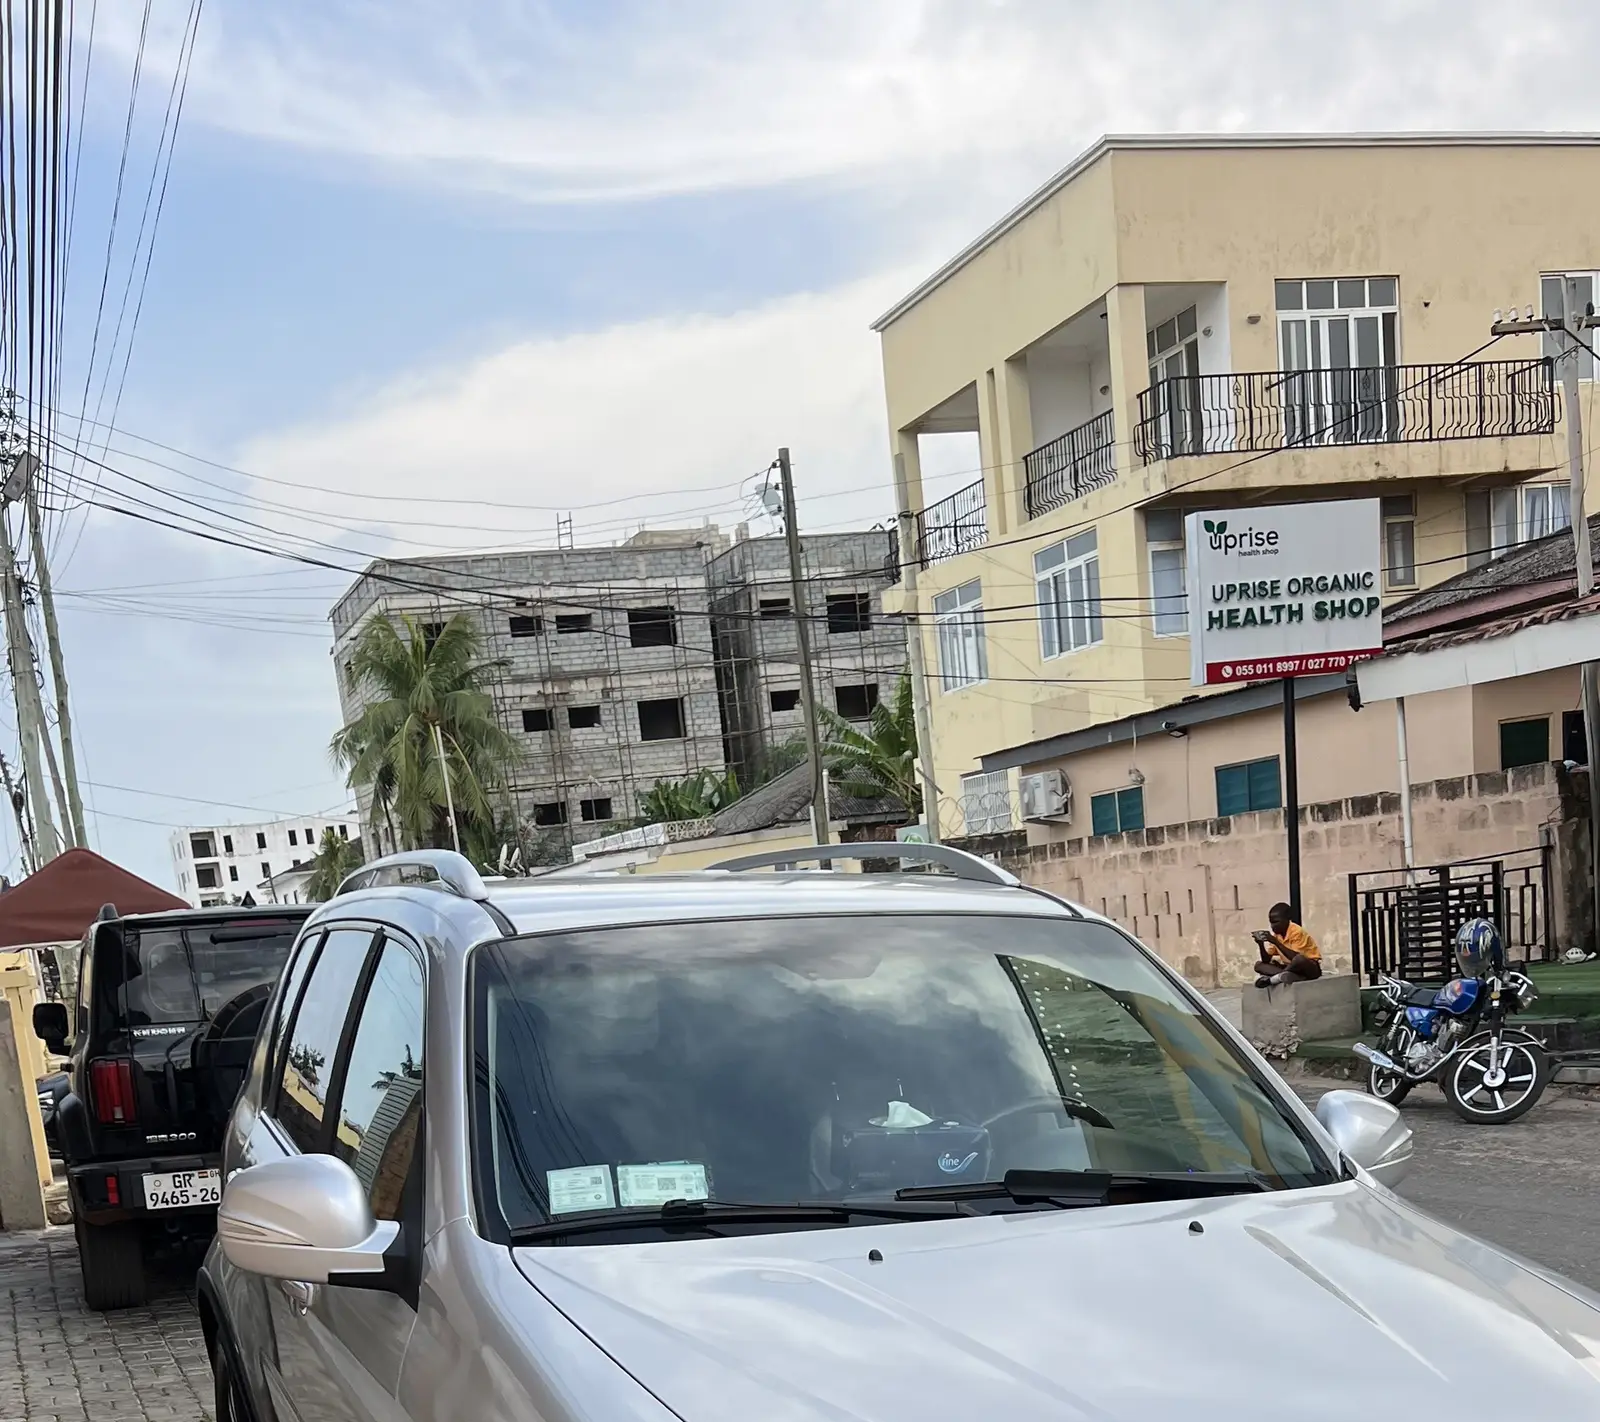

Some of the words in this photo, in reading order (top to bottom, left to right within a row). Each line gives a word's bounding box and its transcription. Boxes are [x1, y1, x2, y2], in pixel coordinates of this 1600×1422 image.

[1210, 527, 1279, 555] uprise
[1238, 549, 1260, 557] health
[1262, 548, 1279, 556] shop
[1212, 580, 1281, 602] UPRISE
[1287, 572, 1374, 597] ORGANIC
[1206, 603, 1304, 631] HEALTH
[1314, 596, 1380, 621] SHOP
[1235, 665, 1254, 676] 055
[1256, 662, 1274, 674] 011
[1276, 660, 1300, 672] 8997
[1308, 658, 1326, 669] 027
[1328, 656, 1346, 668] 770
[172, 1173, 193, 1189] GR
[149, 1187, 220, 1207] 9465-26
